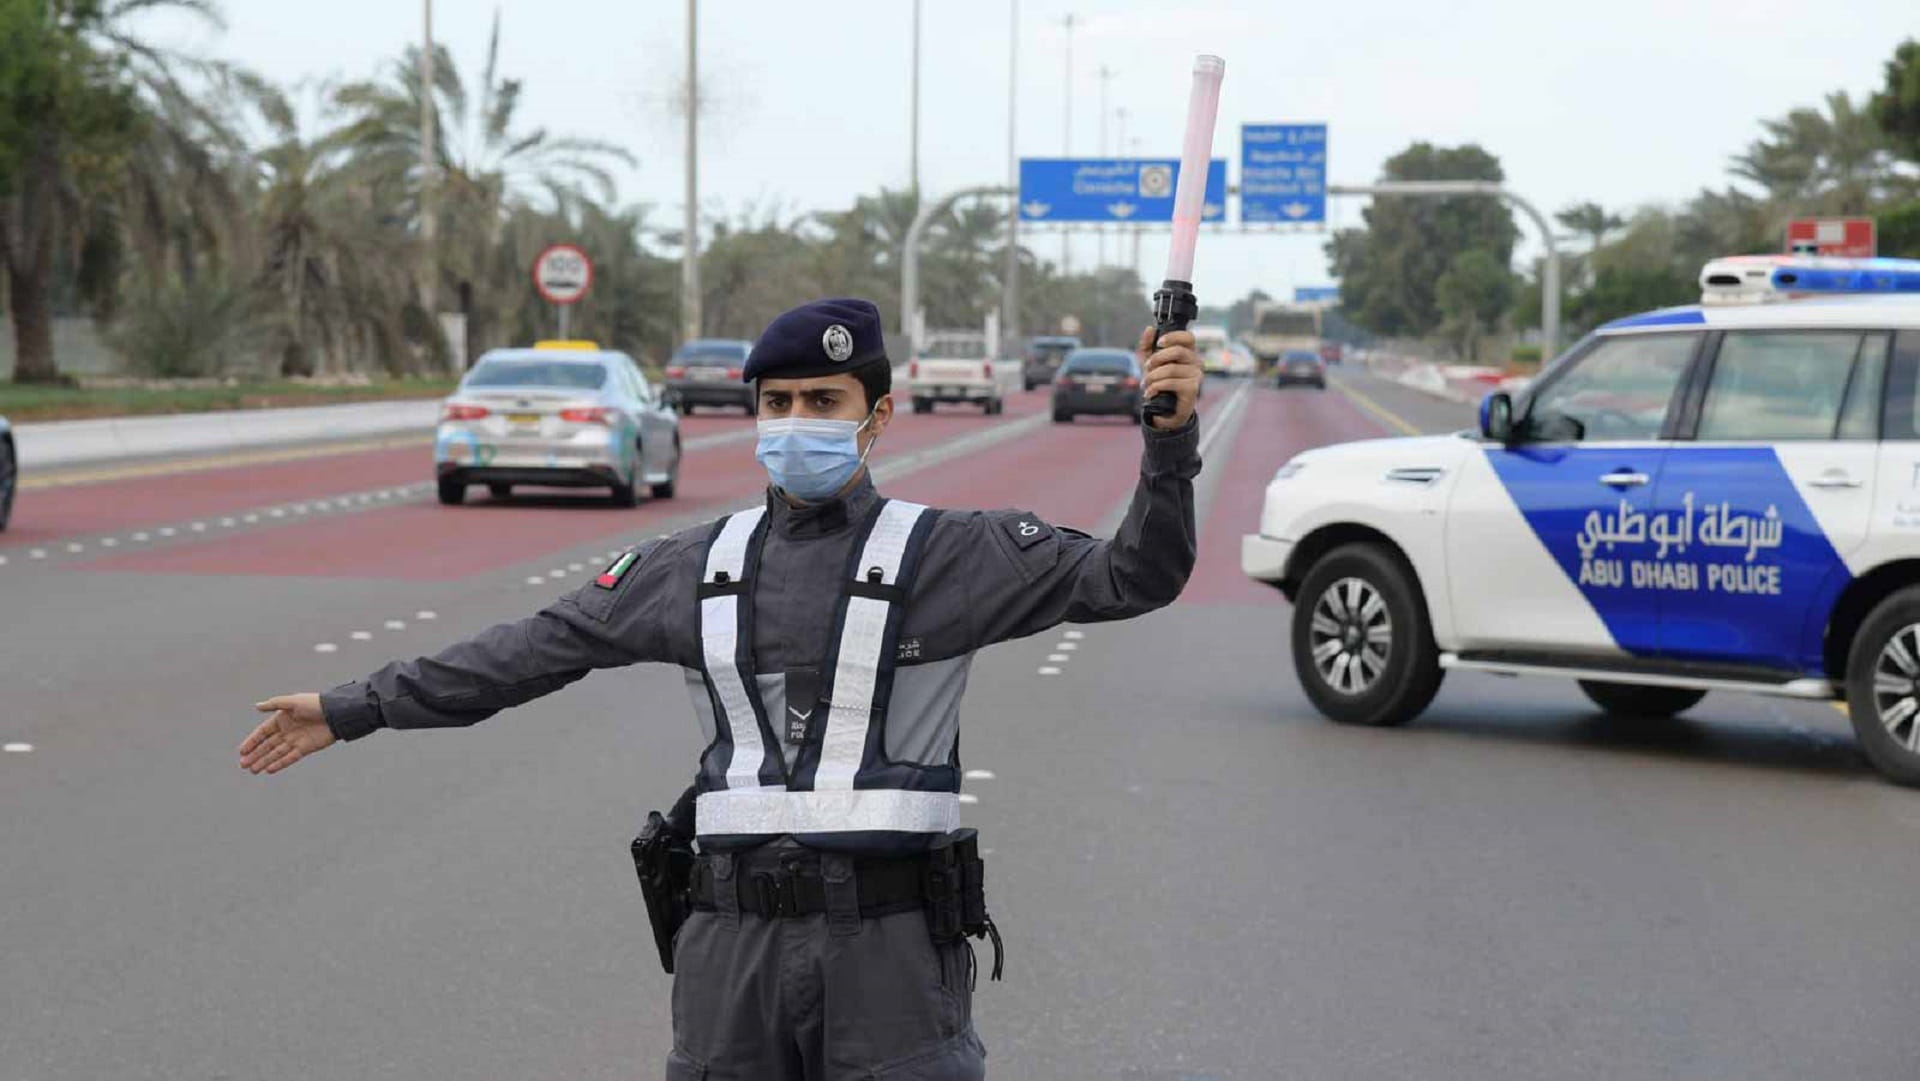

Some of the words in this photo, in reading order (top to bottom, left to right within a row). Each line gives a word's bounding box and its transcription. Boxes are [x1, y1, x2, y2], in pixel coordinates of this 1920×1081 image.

[1699, 502, 1782, 561] شرطة
[1579, 560, 1623, 588] ABU
[1631, 560, 1698, 590] DHABI
[1708, 564, 1781, 595] POLICE
